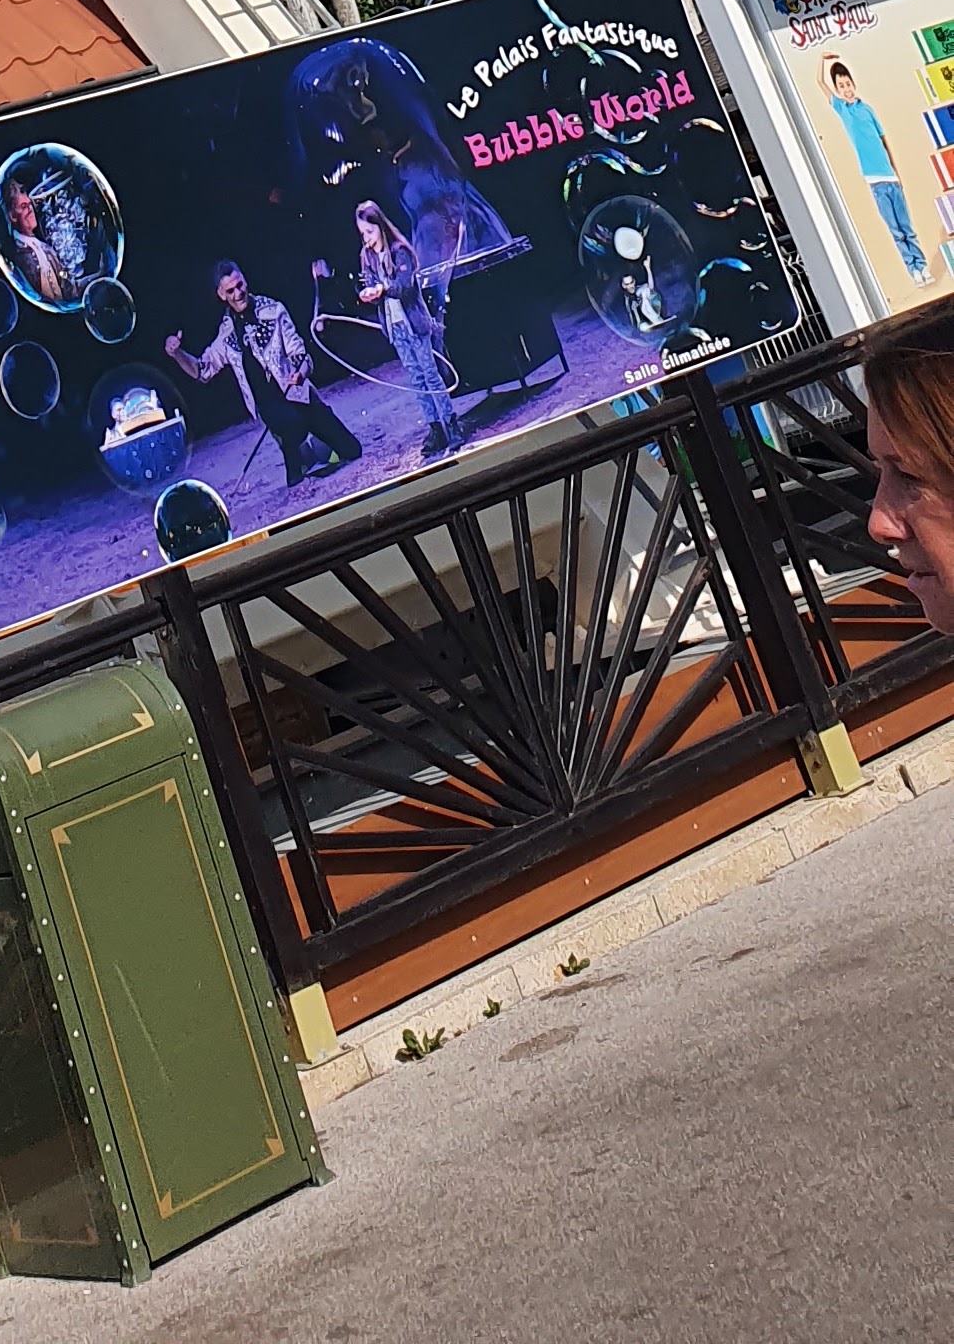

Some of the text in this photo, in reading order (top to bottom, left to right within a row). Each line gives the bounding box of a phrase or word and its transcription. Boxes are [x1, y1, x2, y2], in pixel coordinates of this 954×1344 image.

[789, 1, 875, 47] SAINT PAUL
[447, 20, 679, 119] Le Palais Fantastique
[464, 69, 696, 168] Bubble World
[624, 336, 731, 385] Salle climatisée
